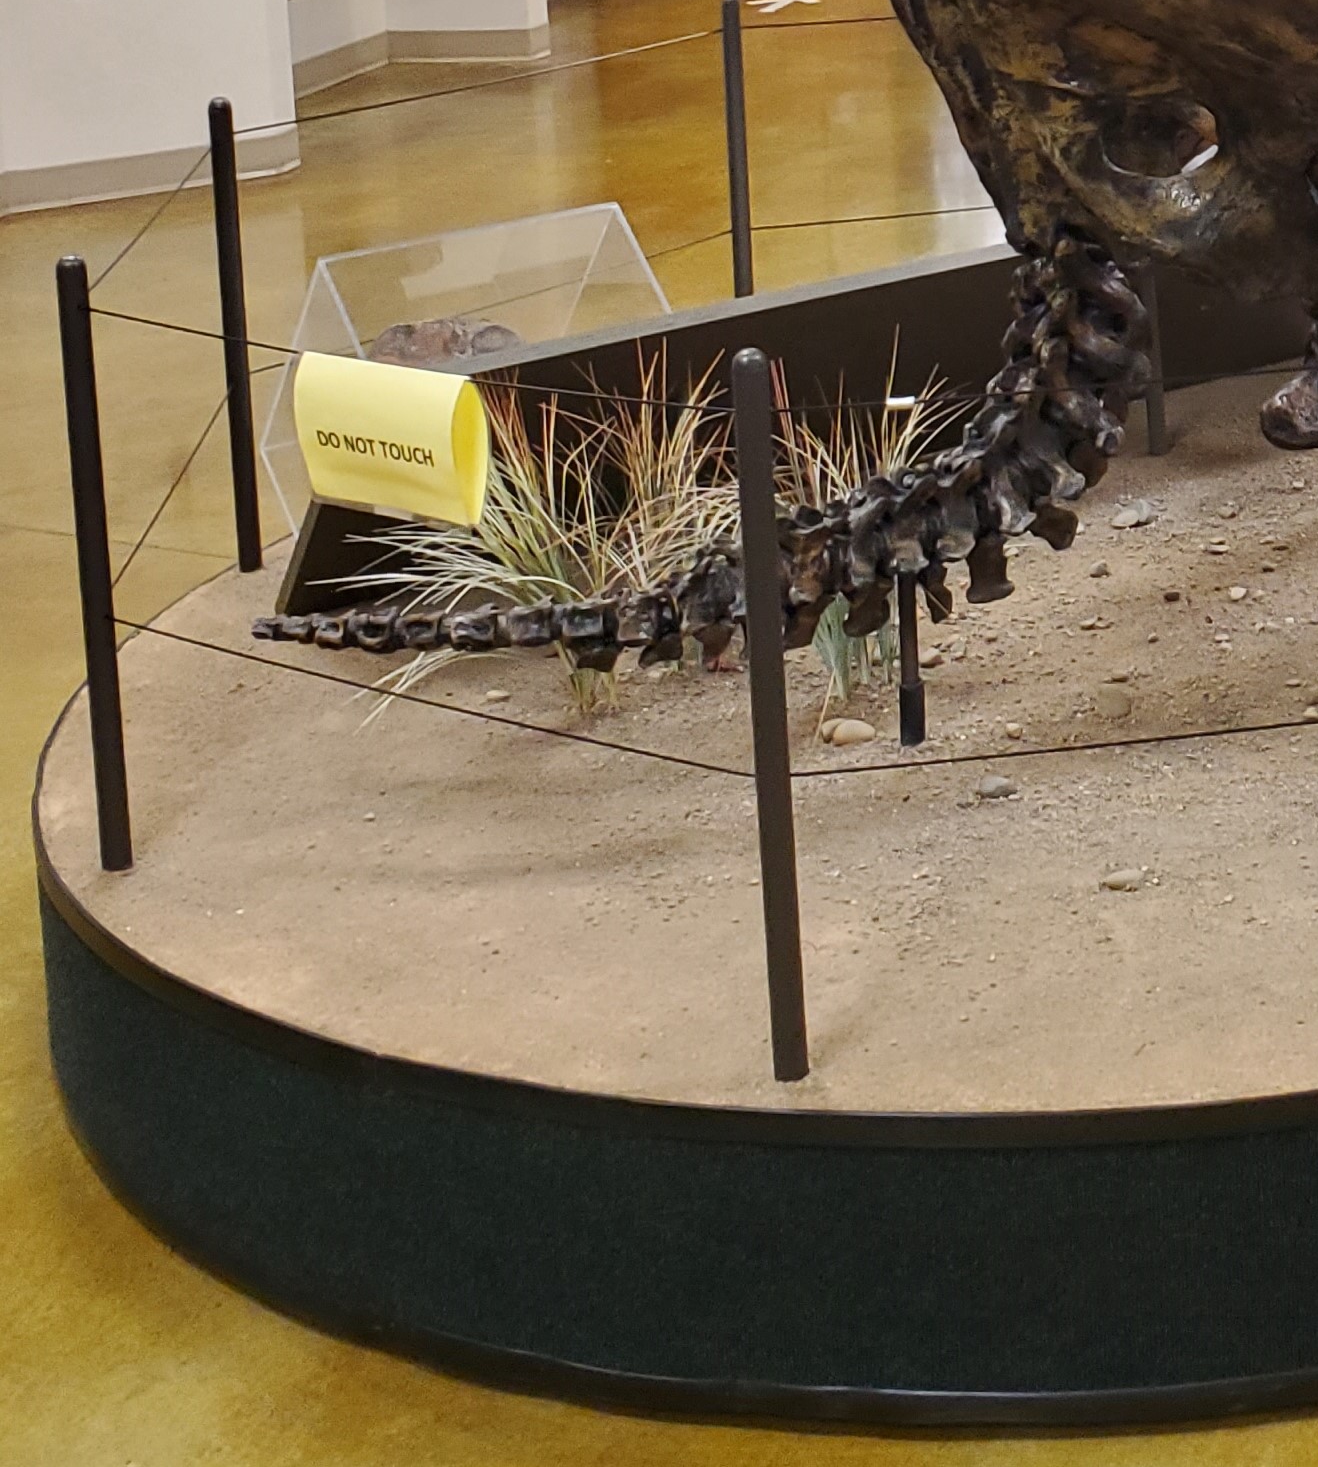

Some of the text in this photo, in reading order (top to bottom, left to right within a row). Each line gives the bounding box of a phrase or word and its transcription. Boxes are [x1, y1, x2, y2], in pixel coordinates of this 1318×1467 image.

[316, 430, 435, 468] DO NOT TOUCH
